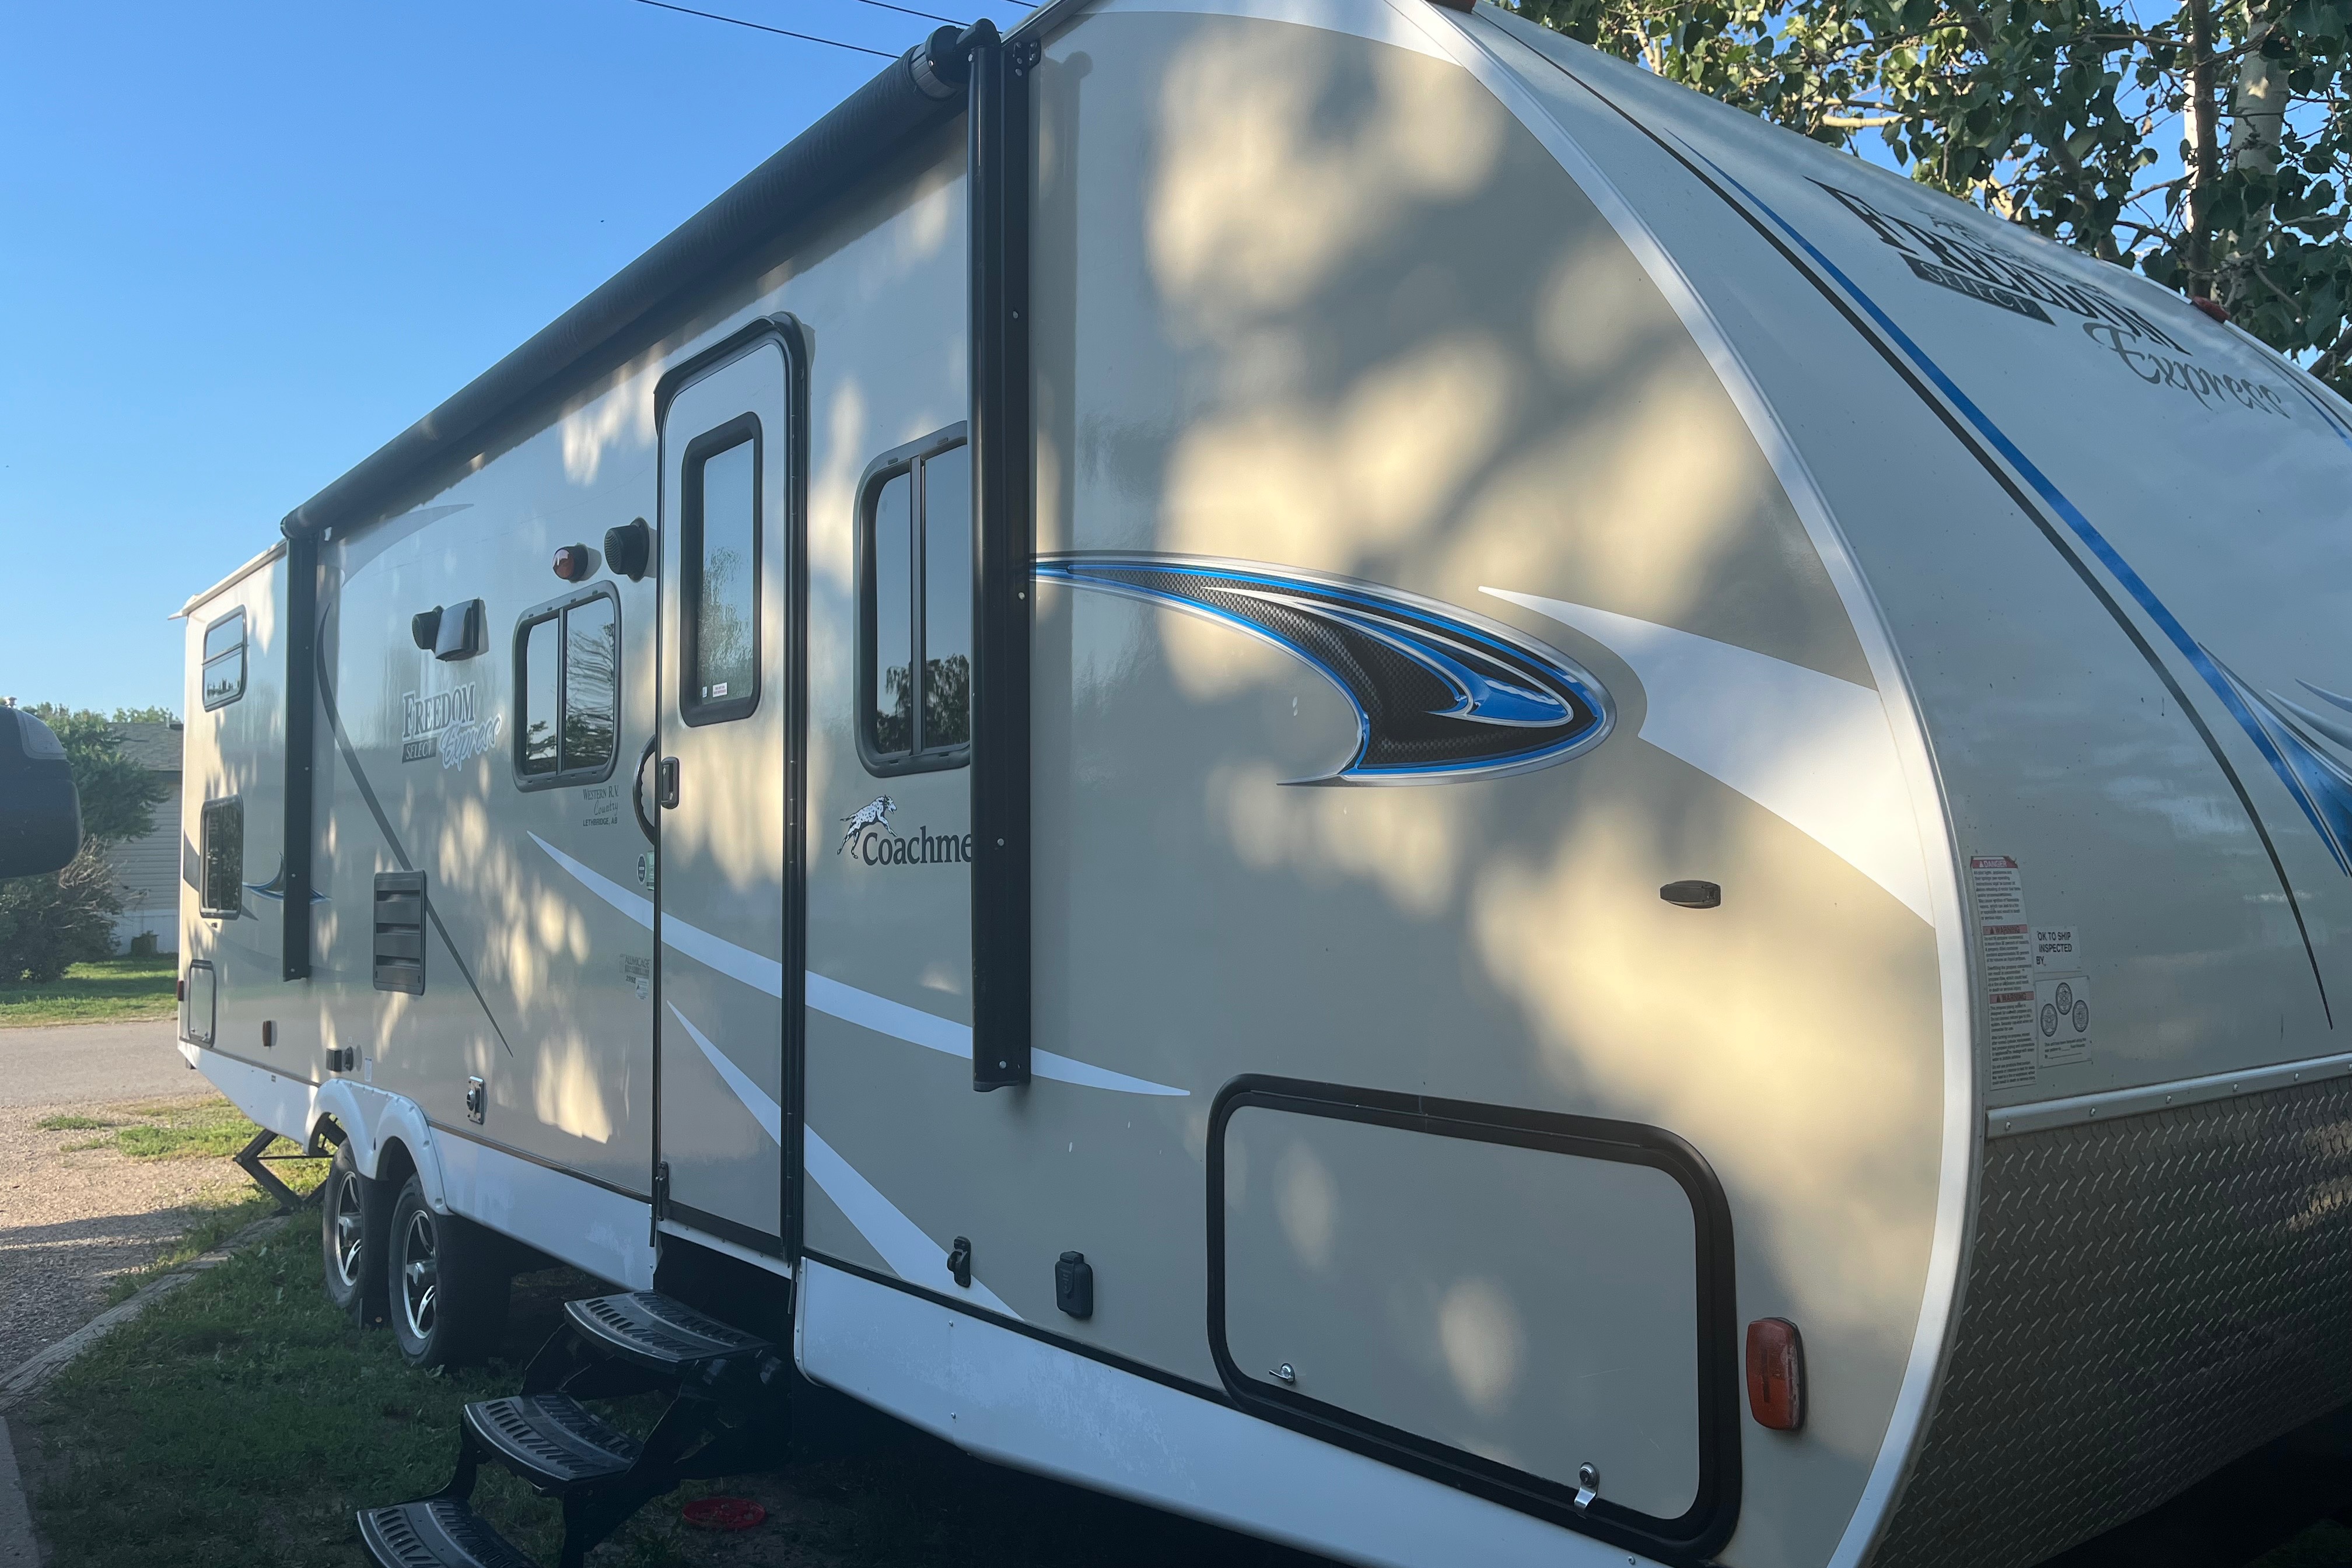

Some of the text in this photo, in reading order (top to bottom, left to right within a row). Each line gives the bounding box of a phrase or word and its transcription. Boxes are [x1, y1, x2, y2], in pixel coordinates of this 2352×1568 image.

[1803, 175, 2193, 356] FREEDOM
[1920, 262, 2030, 313] SELECT
[2082, 321, 2291, 419] Express
[403, 684, 475, 738] FREEDOM
[406, 740, 433, 760] SELECT
[440, 715, 502, 771] Express
[583, 787, 607, 801] WESTERN
[594, 799, 618, 817] Country
[862, 825, 972, 866] Coachme
[1983, 860, 2007, 868] DANGER
[2038, 932, 2071, 941] OK TO SHIP
[2039, 943, 2073, 953] INSPECTED
